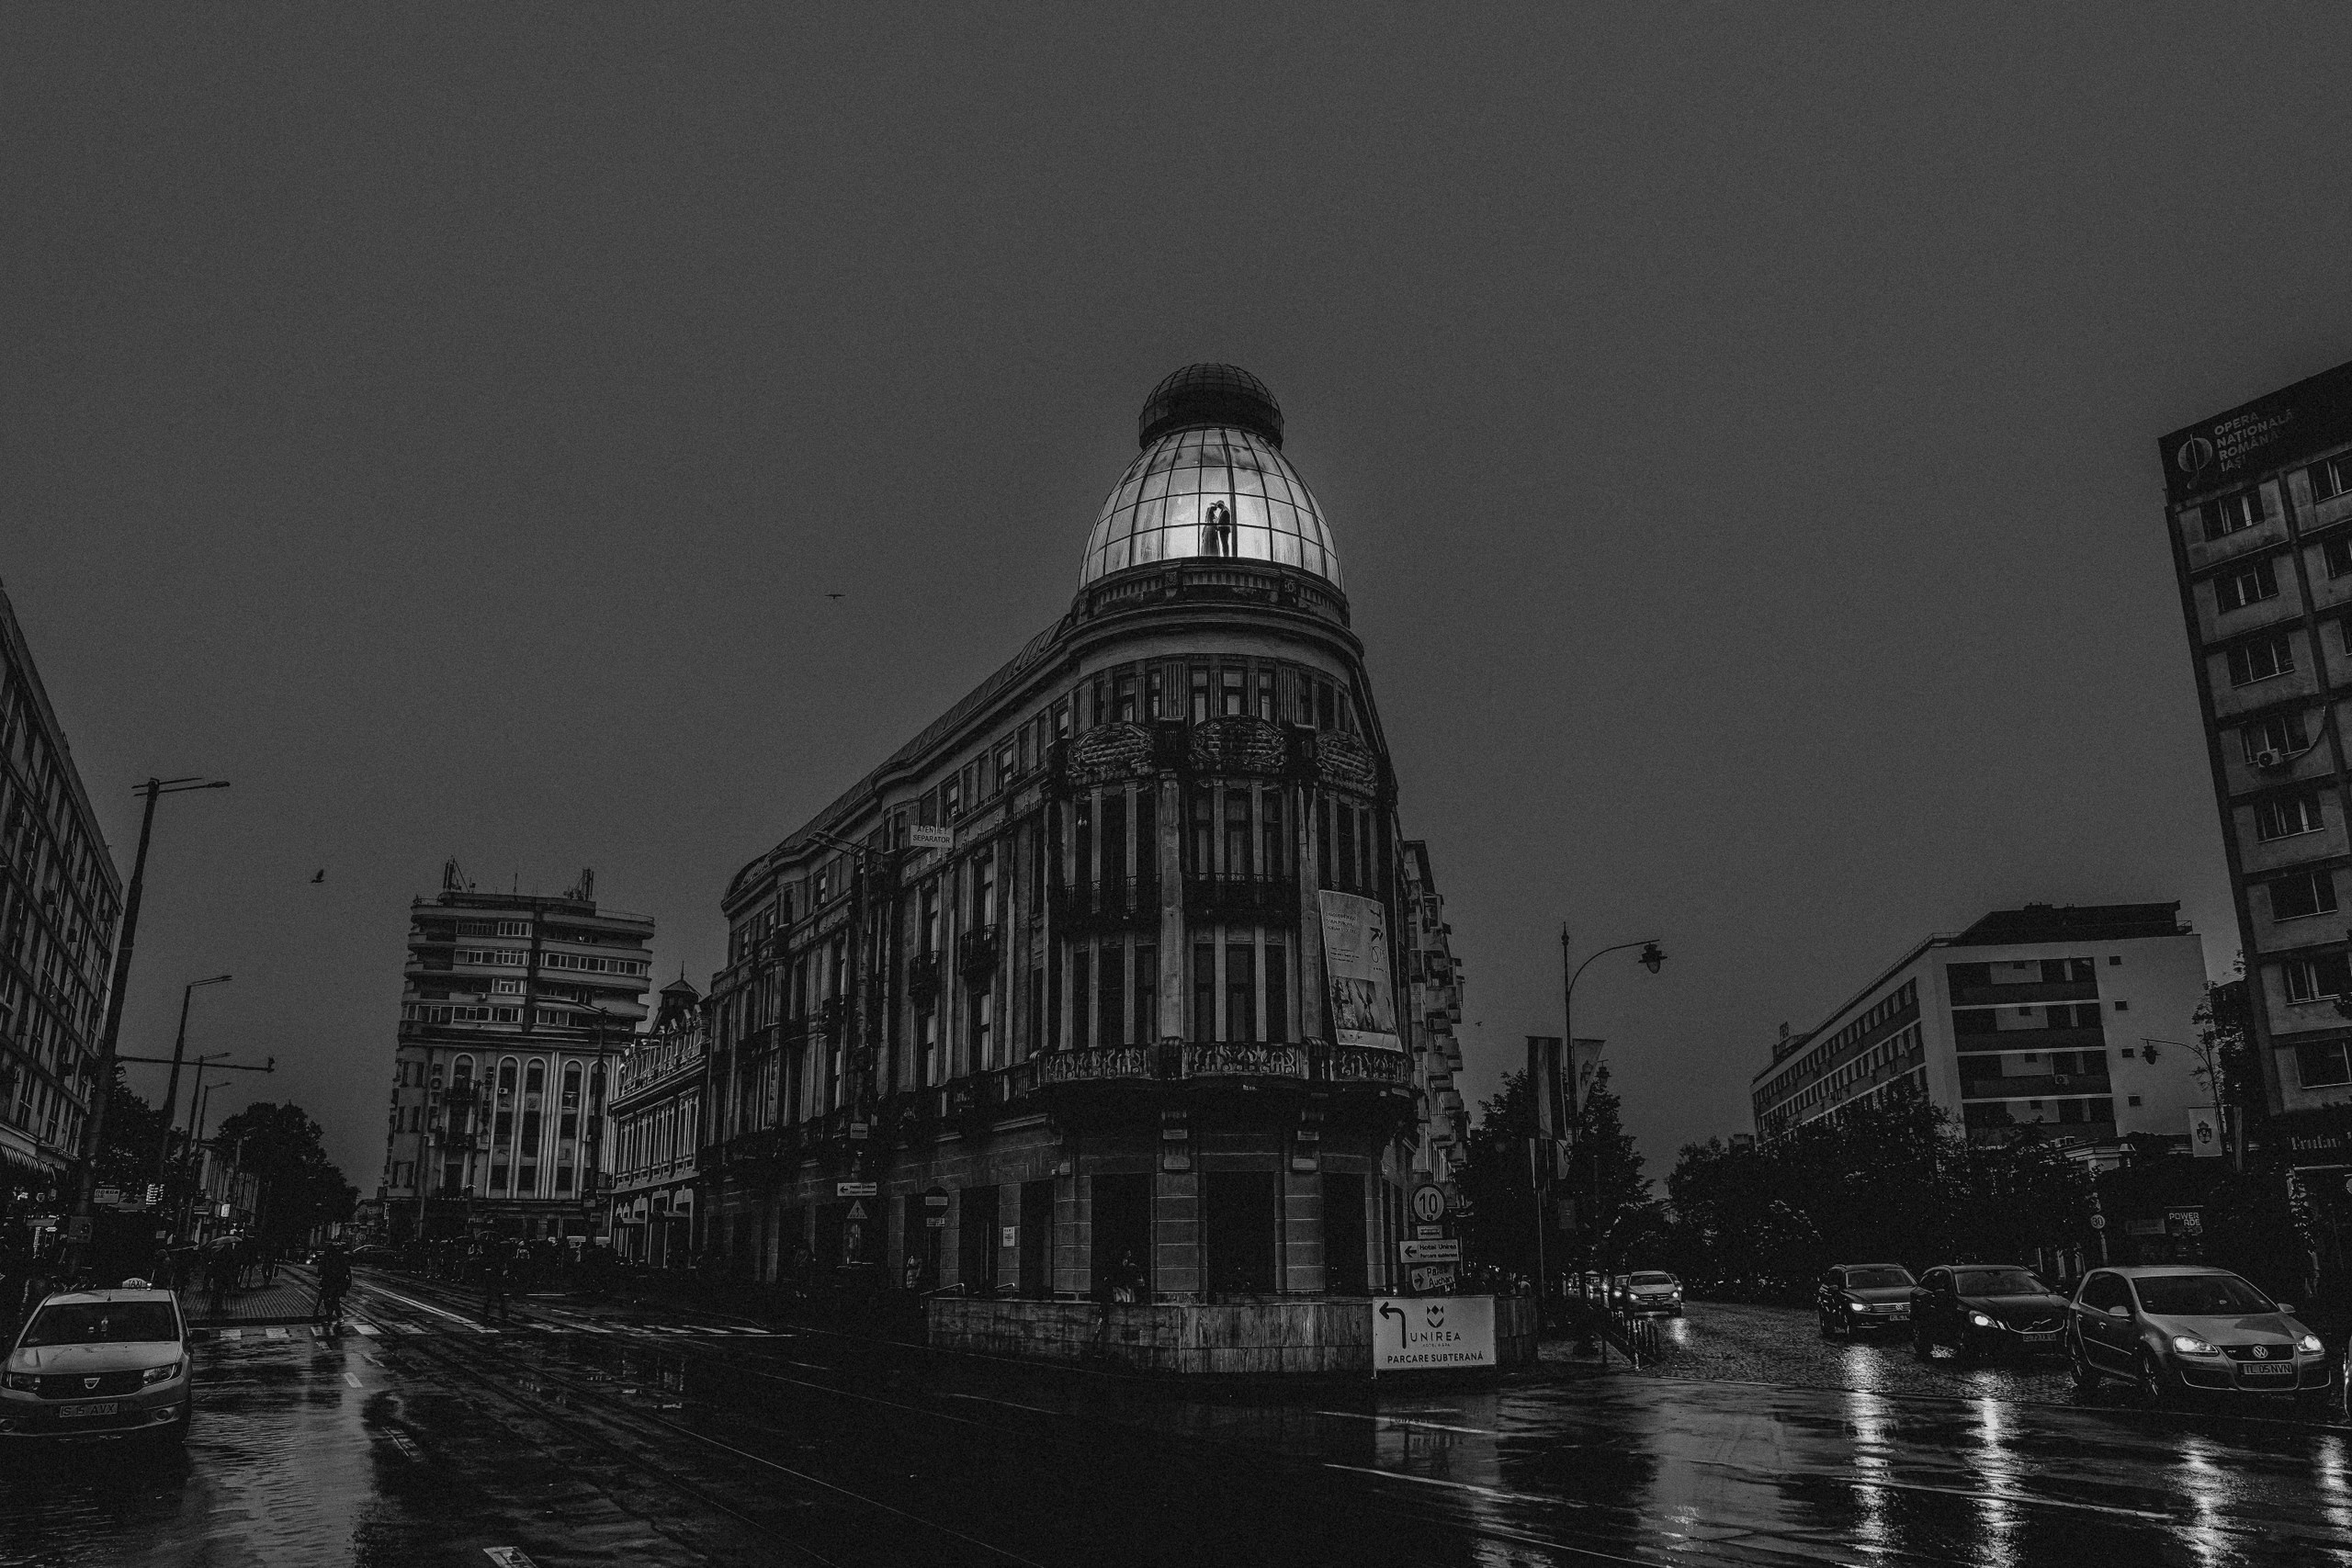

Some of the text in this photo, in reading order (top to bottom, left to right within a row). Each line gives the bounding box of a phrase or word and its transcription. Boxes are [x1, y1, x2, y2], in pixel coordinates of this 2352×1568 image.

[2214, 412, 2259, 435] OPERA
[912, 834, 950, 843] SEPARATOR
[428, 1064, 443, 1134] HOTEL
[1419, 1193, 1438, 1214] 10
[2092, 1216, 2104, 1226] 30
[2168, 1212, 2199, 1220] POWER
[129, 1280, 142, 1288] TAXI
[1429, 1276, 1453, 1288] Auchan
[1409, 1331, 1461, 1343] UNIREA
[1387, 1354, 1429, 1364] PARCARE
[2245, 1364, 2290, 1373] TL 05 NVN
[75, 1406, 85, 1416] 15
[90, 1404, 115, 1415] AVX
